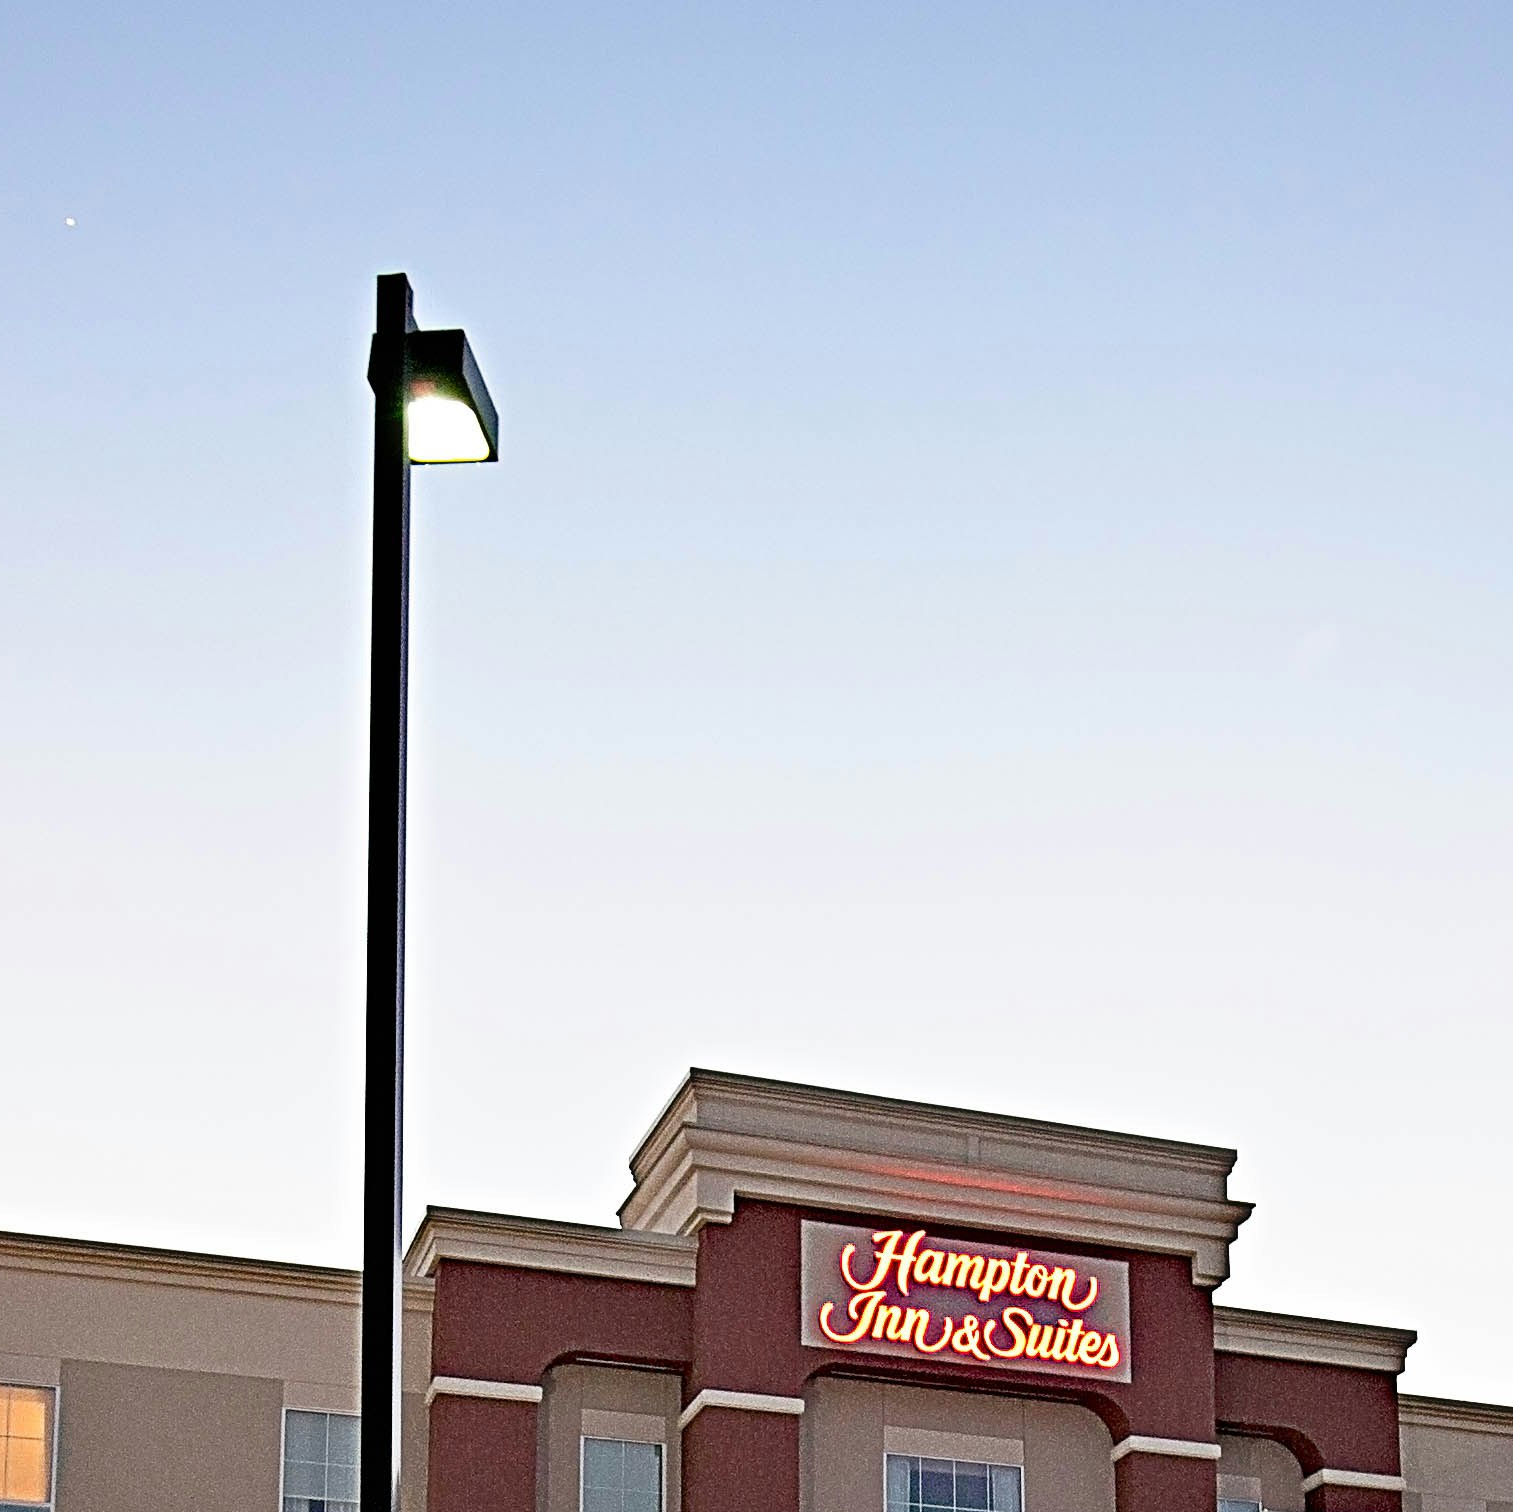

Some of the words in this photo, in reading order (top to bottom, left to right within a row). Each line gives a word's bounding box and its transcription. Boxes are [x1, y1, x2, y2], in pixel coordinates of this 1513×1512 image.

[841, 1230, 1098, 1311] Hampton
[819, 1290, 952, 1352] Inn
[951, 1315, 991, 1361] &
[984, 1306, 1121, 1369] Suites
